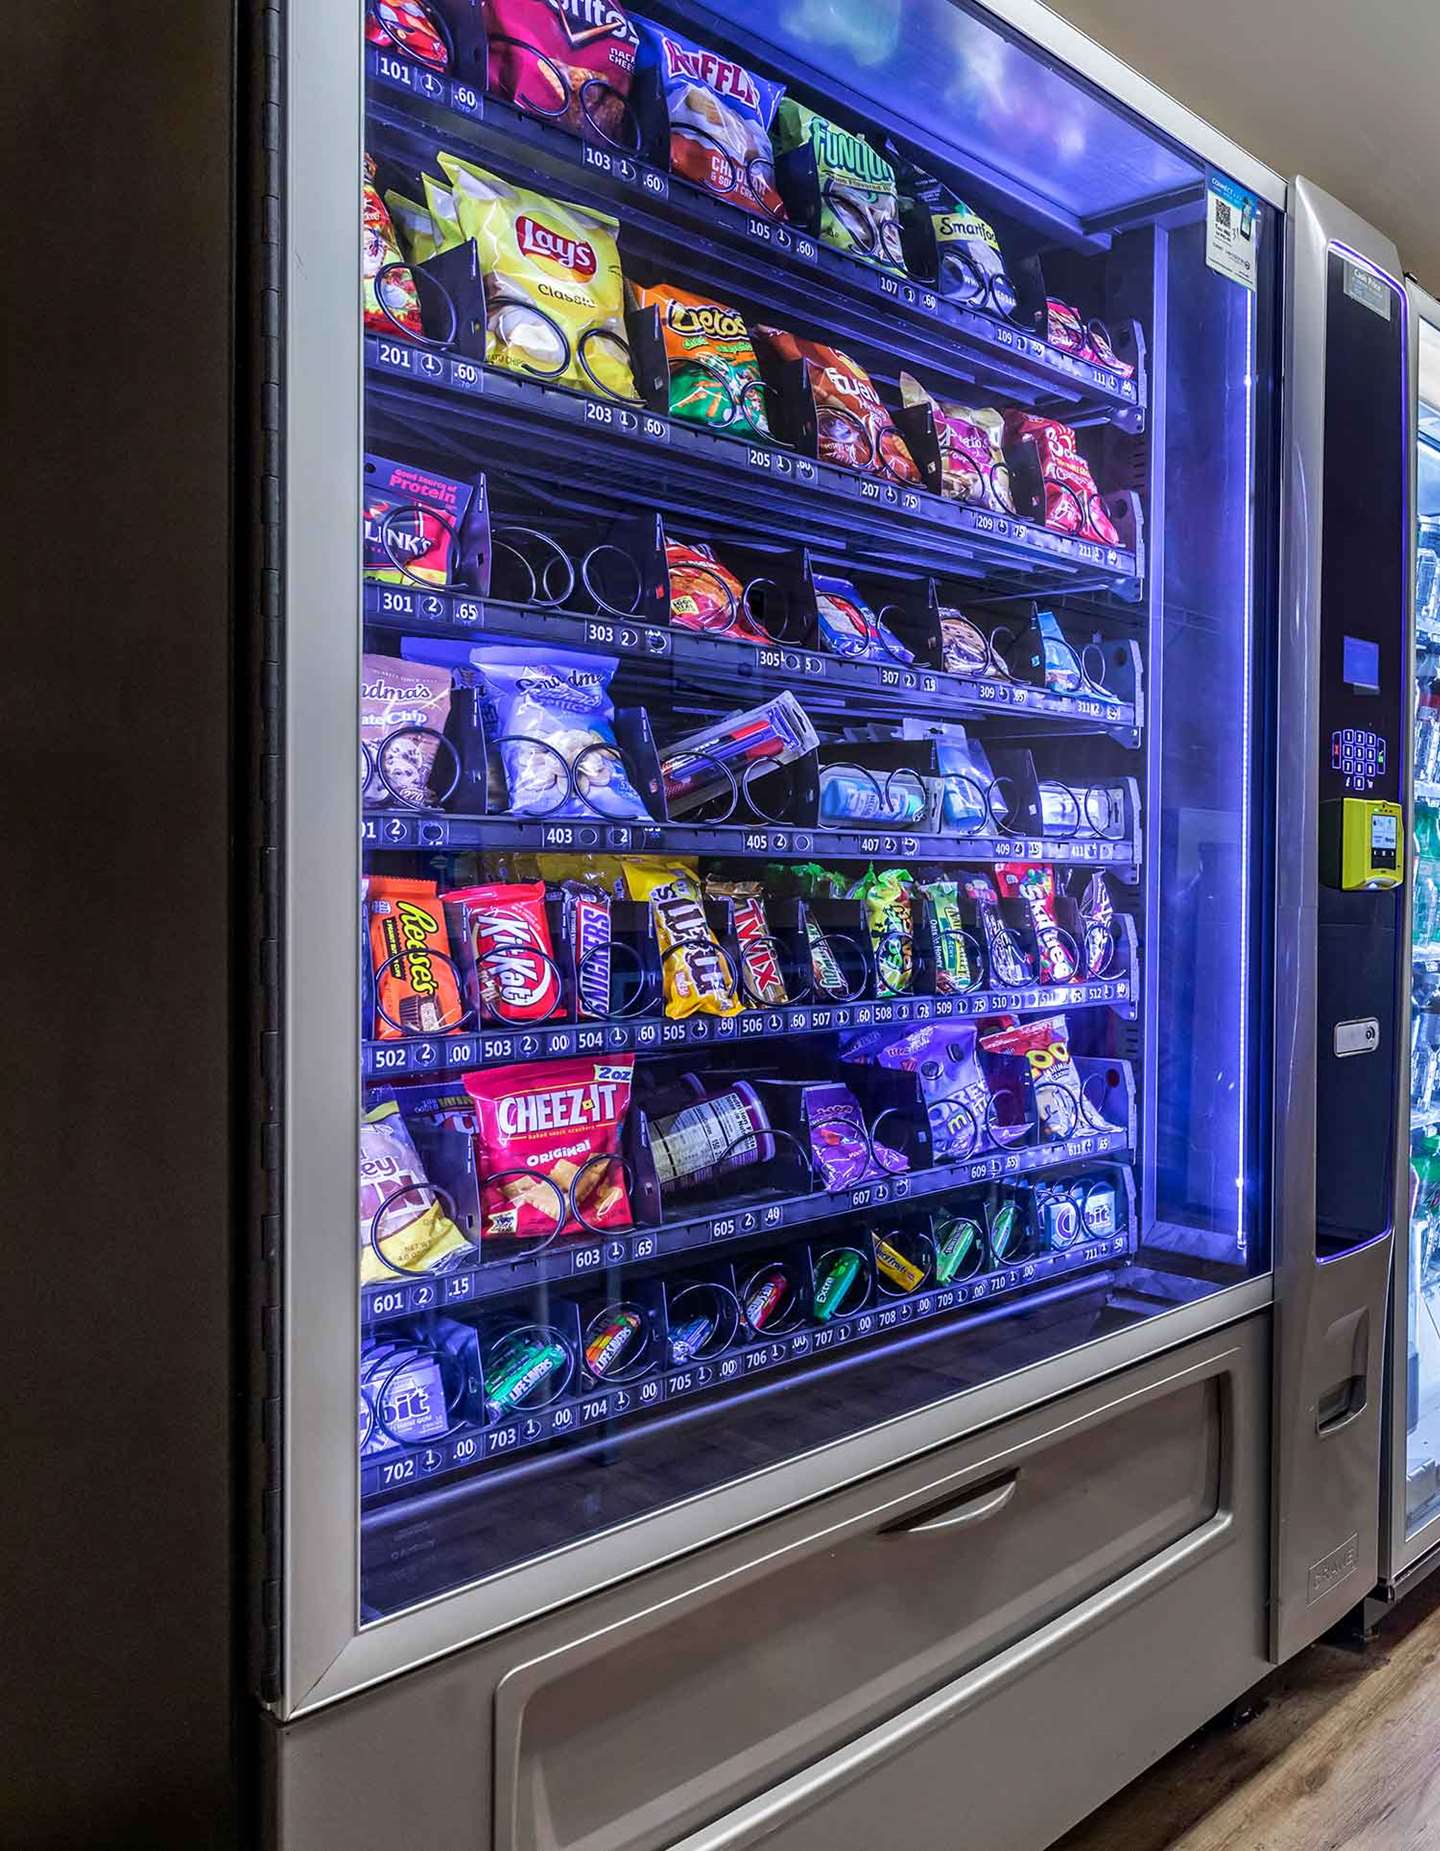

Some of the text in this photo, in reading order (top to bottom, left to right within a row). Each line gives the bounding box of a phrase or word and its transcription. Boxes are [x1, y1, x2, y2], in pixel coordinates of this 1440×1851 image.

[381, 56, 475, 106] 101 1 .60
[586, 147, 661, 191] 103 1 .60
[524, 219, 591, 269] Lay's
[750, 220, 811, 256] 105 1 .60
[538, 283, 597, 308] Classic
[880, 276, 898, 294] 107
[908, 290, 913, 301] 1
[997, 329, 1012, 344] 109
[380, 344, 475, 381] 201 1 .60
[1093, 371, 1105, 384] 111
[587, 404, 661, 434] 203 1 .60
[750, 449, 783, 467] 205 1
[389, 475, 456, 504] Protein
[861, 483, 879, 497] 207
[978, 515, 993, 529] 209
[383, 593, 476, 620] 301 2 .65
[589, 624, 613, 642] 303
[621, 632, 628, 646] 2
[760, 651, 779, 666] 305
[882, 670, 899, 684] 307
[904, 676, 911, 686] 2
[980, 686, 995, 698] 309
[1078, 701, 1090, 713] 311
[388, 710, 427, 726] Chip
[391, 819, 400, 834] 2
[547, 828, 572, 843] 403
[747, 834, 783, 848] 405 2
[861, 838, 879, 850] 407
[885, 838, 891, 848] 2
[996, 843, 1010, 854] 409
[1071, 843, 1084, 855] 411
[397, 900, 438, 994] Reese's
[735, 897, 781, 993] TWIX
[580, 907, 610, 1015] SNICKERS
[992, 995, 1018, 1009] 510 1
[1089, 988, 1102, 999] 512
[812, 1008, 870, 1026] 507 1 .60
[875, 1006, 908, 1020] 508 1
[937, 1001, 952, 1014] 509
[959, 1001, 965, 1012] 1
[663, 1024, 685, 1040] 505
[718, 1018, 733, 1031] .60
[742, 1014, 805, 1032] 506 1 .60
[485, 1035, 568, 1057] 503 2 .00
[579, 1026, 654, 1047] 504 1 .60
[376, 1044, 470, 1067] 502 2 .00
[1068, 1145, 1081, 1155] 611
[971, 1166, 986, 1178] 609
[853, 1191, 870, 1205] 607
[877, 1186, 884, 1197] 1
[713, 1220, 734, 1237] 605
[745, 1213, 752, 1226] 2
[575, 1240, 653, 1267] 603 1 .65
[1085, 1249, 1098, 1259] 711
[817, 1277, 834, 1302] Extra
[991, 1277, 1005, 1291] 710
[374, 1277, 469, 1313] 601 2 .15
[938, 1293, 953, 1308] 709
[879, 1312, 896, 1327] 708
[917, 1299, 930, 1312] .00
[815, 1318, 871, 1346] 707 1 .00
[747, 1352, 767, 1368] 706
[772, 1346, 778, 1356] 1
[670, 1361, 735, 1393] 705 1 .00
[583, 1383, 657, 1420] 704 1 .00
[489, 1409, 571, 1450] 703 1 .00
[384, 1440, 474, 1484] 702 1 .00
